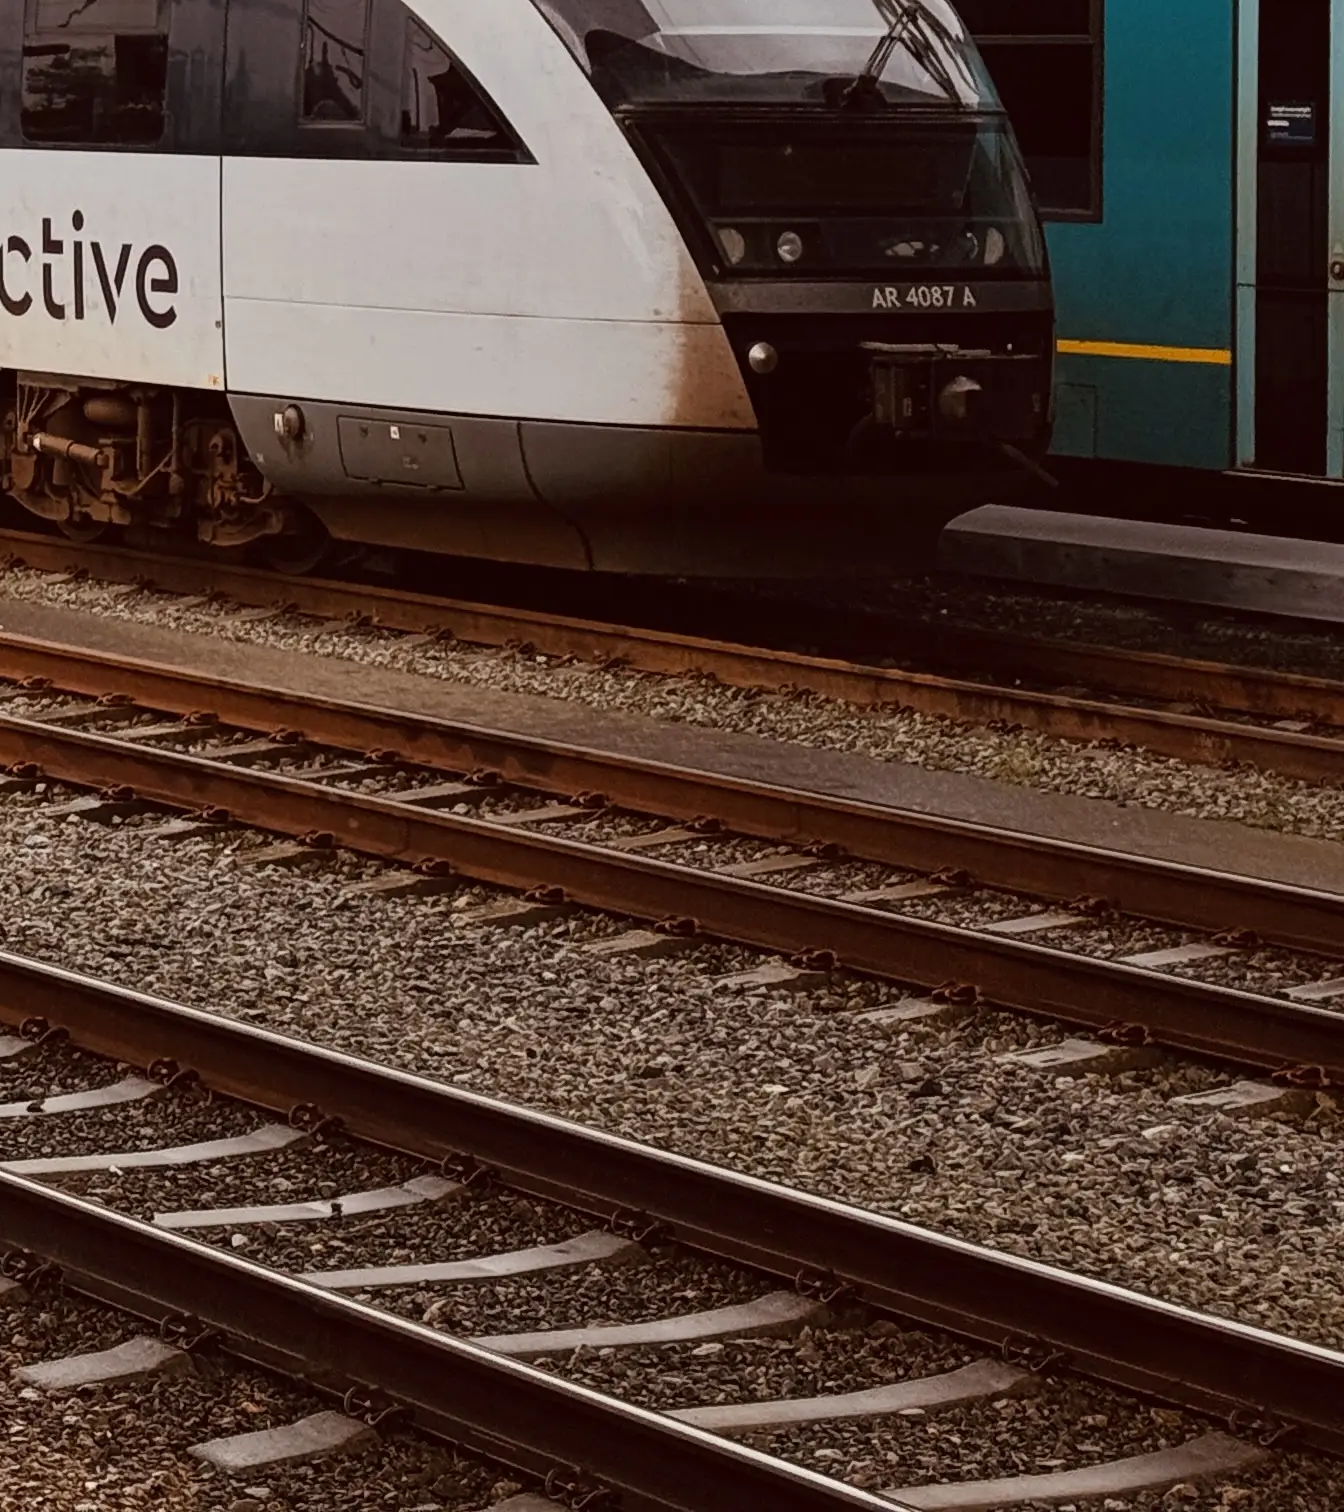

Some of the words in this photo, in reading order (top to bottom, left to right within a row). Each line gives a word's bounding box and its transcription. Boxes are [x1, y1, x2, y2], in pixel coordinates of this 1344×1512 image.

[872, 287, 902, 308] AR
[905, 285, 955, 307] 4087
[962, 285, 976, 307] A
